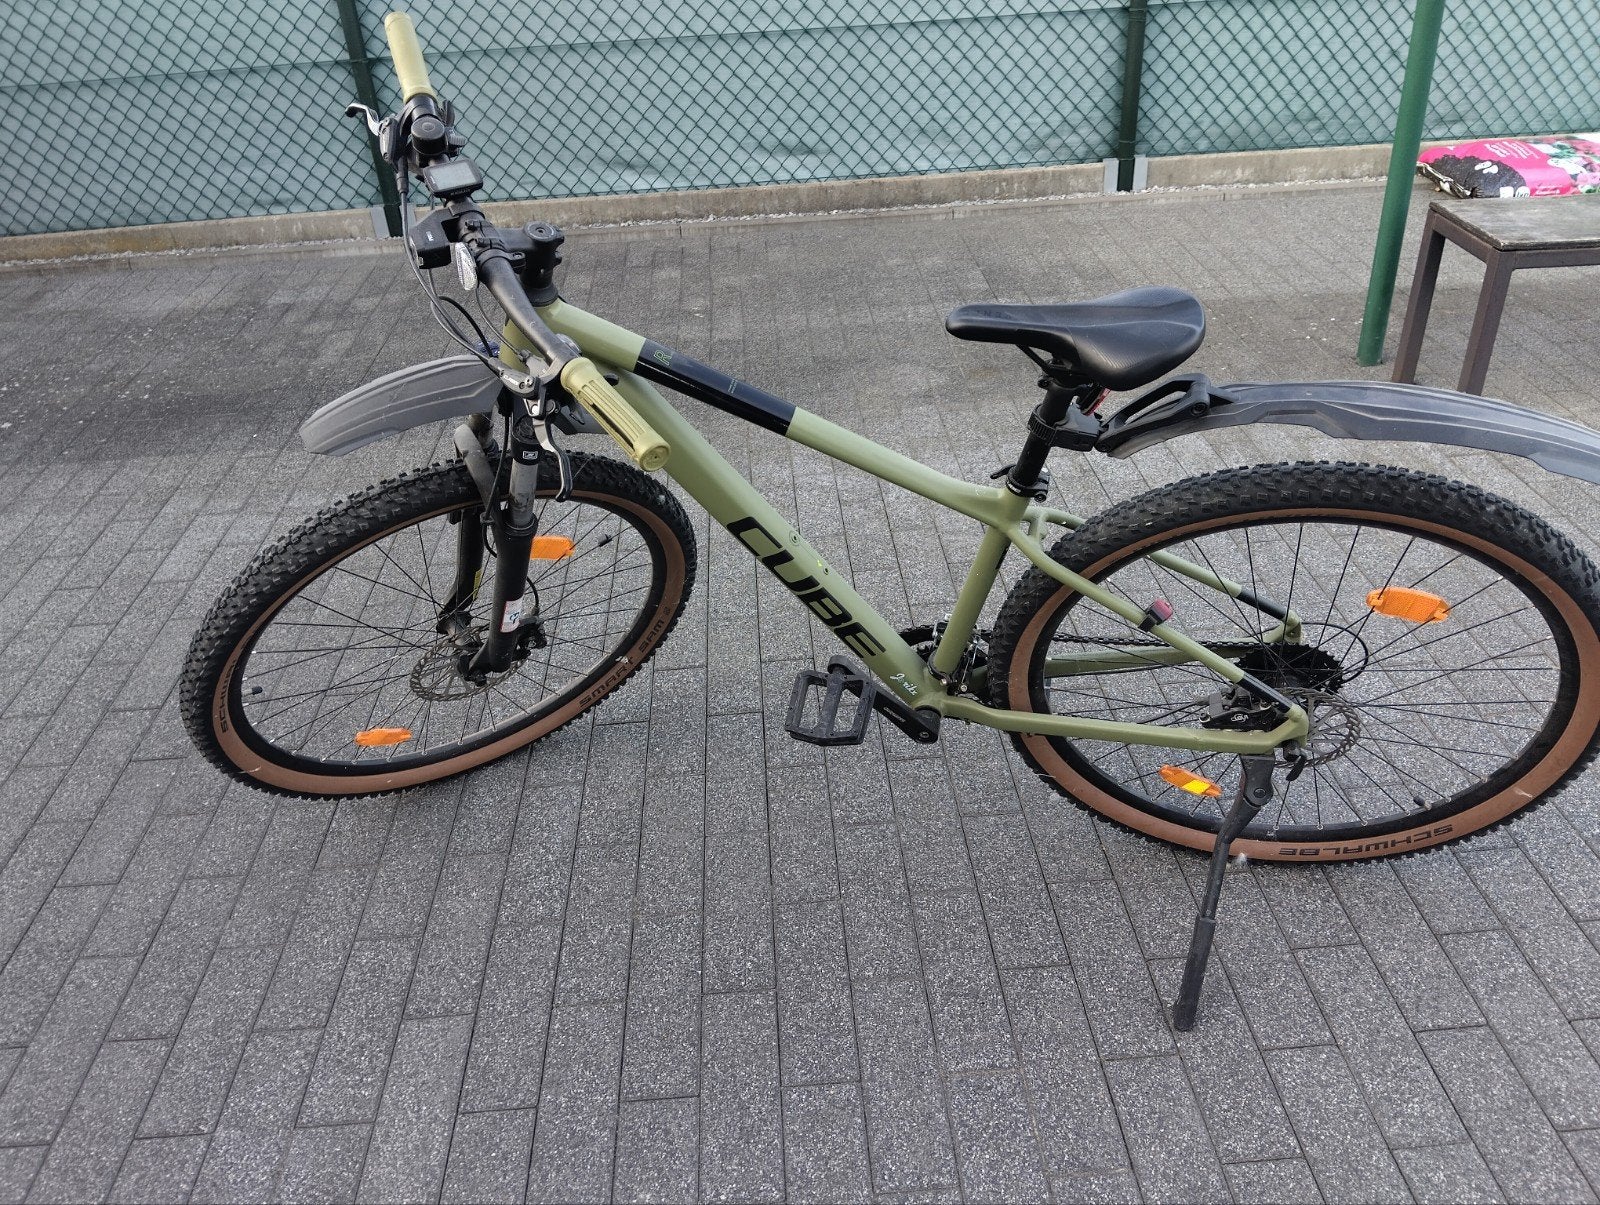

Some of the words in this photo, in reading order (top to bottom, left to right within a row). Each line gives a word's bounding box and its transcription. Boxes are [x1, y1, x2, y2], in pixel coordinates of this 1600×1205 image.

[726, 516, 887, 658] CUBE
[578, 656, 635, 708] SMART
[638, 620, 665, 654] SAM
[1278, 824, 1454, 857] SCHWALBE
